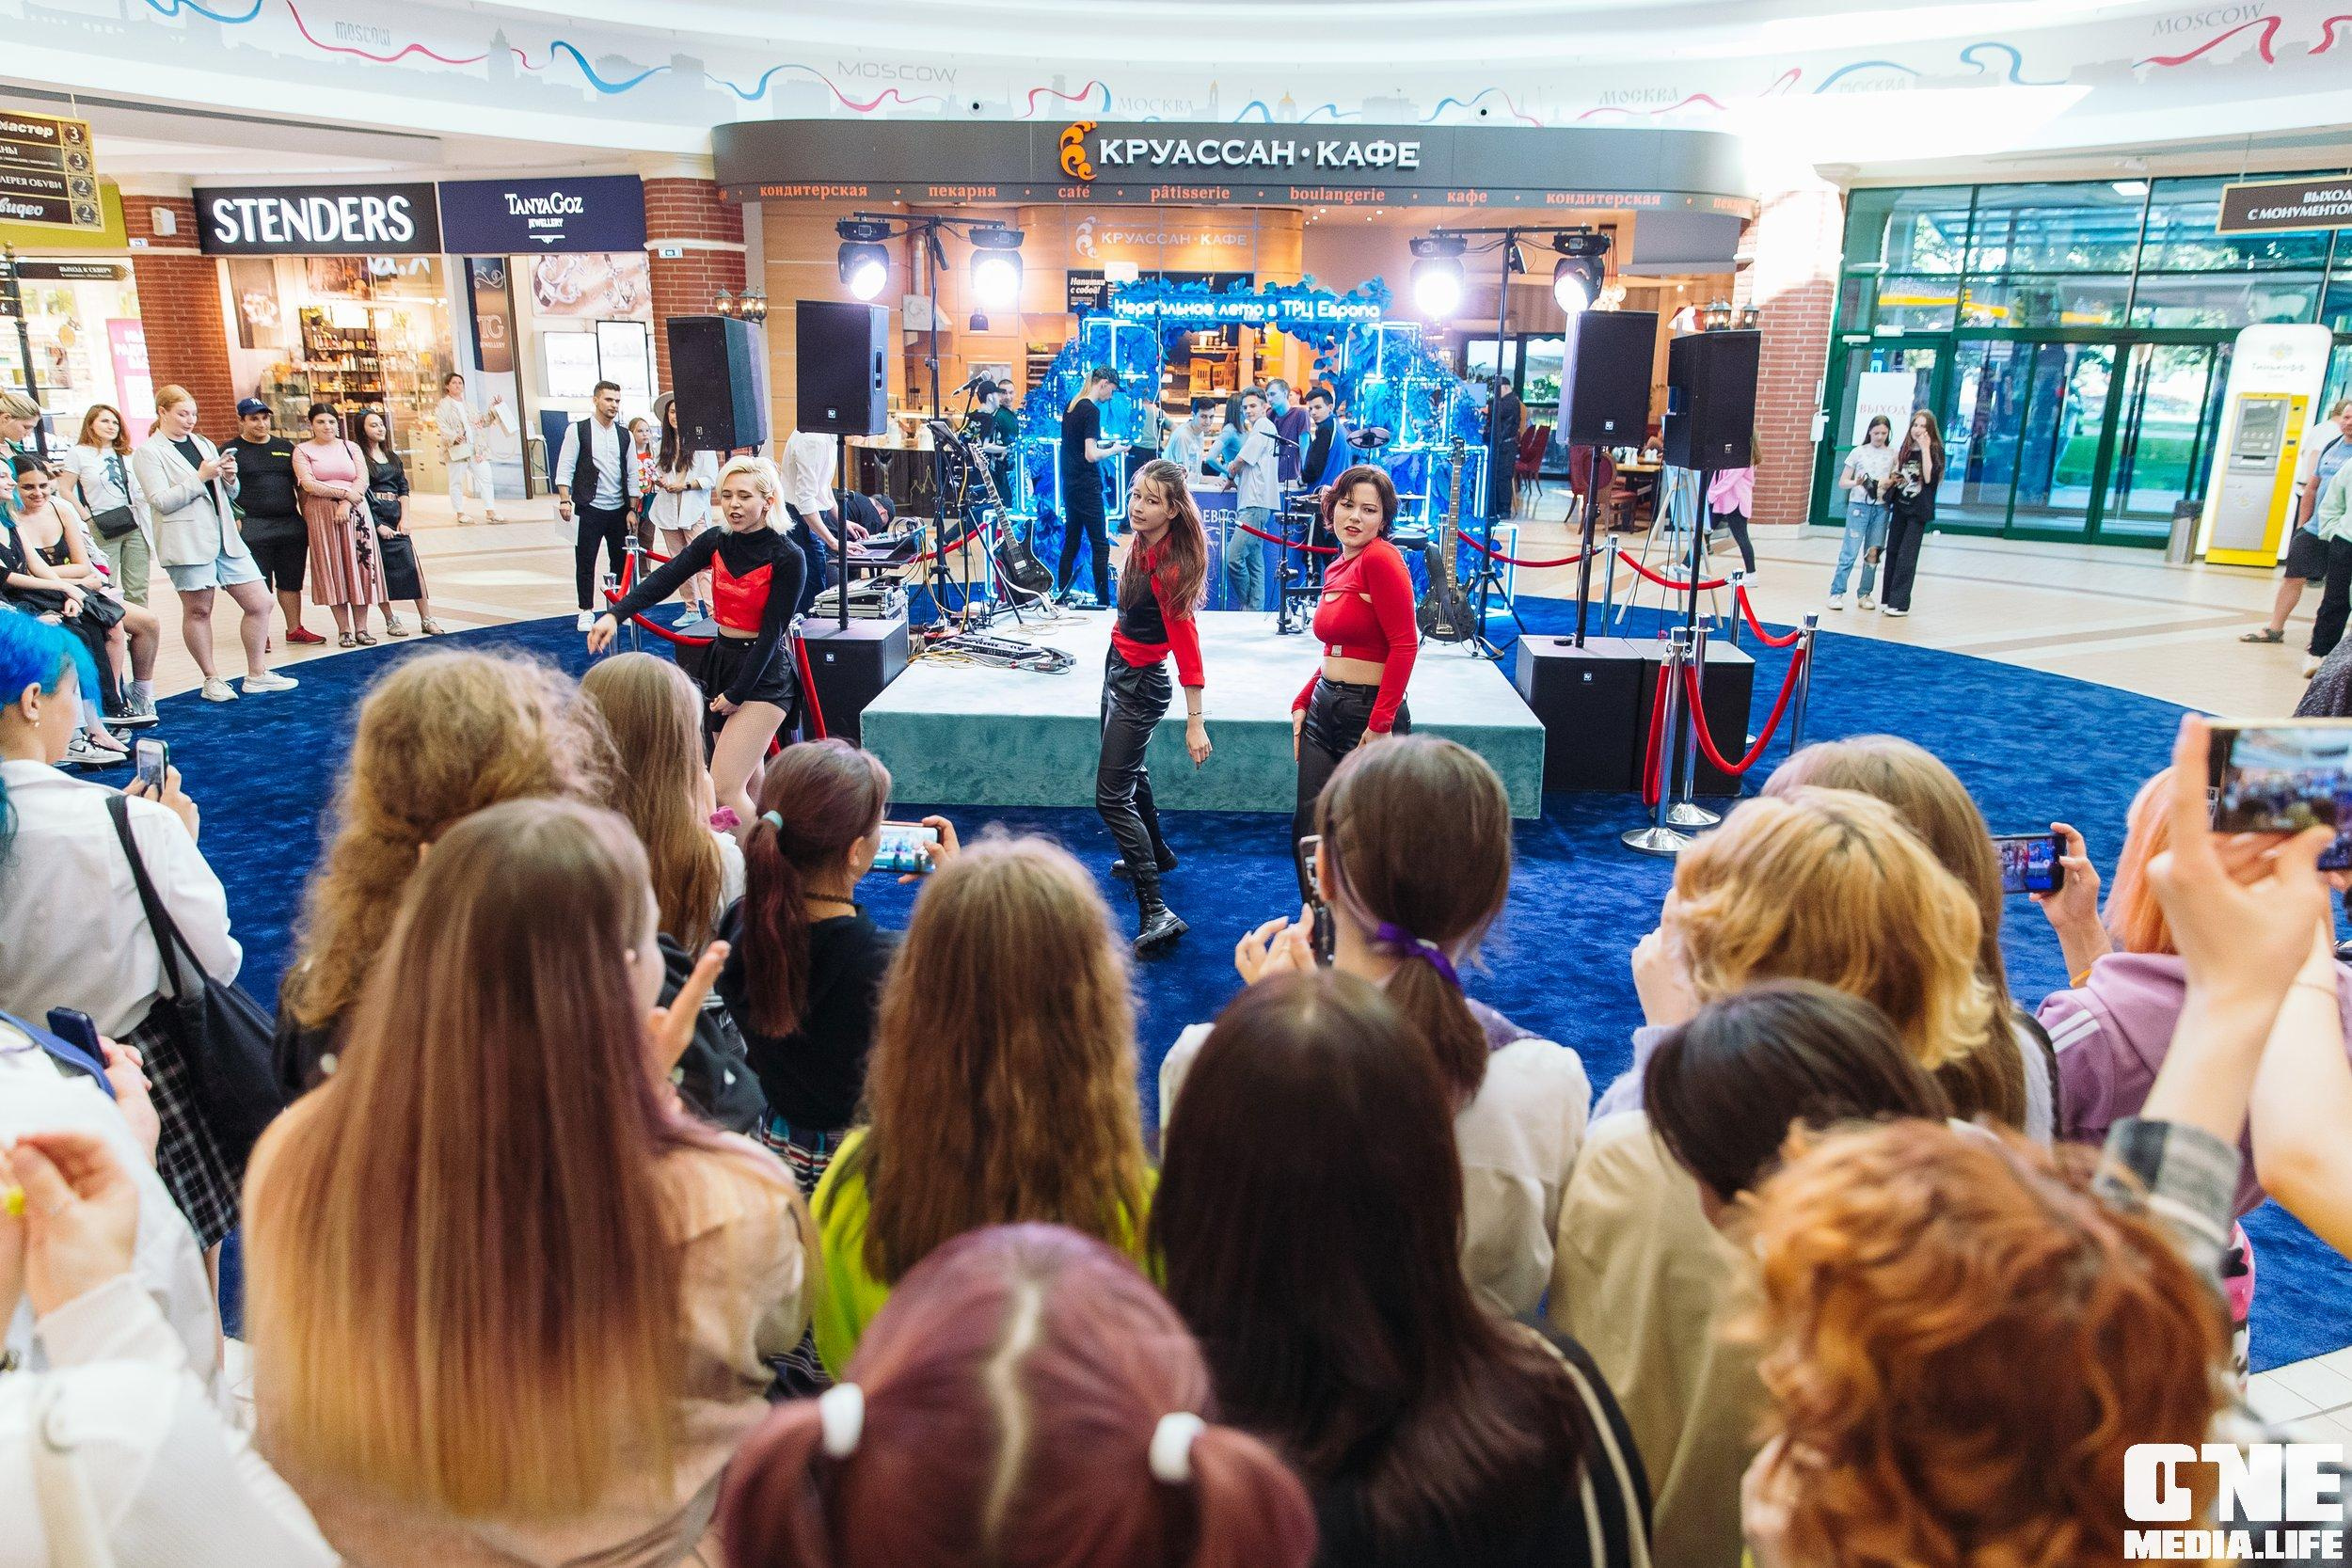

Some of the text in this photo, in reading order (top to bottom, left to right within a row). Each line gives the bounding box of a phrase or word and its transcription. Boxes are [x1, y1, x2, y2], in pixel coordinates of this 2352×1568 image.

[2152, 3, 2265, 37] MOSCOW
[837, 60, 957, 82] MOSCOW
[1117, 96, 1196, 113] МОСКВА
[1099, 138, 1422, 169] КРУАССАН КАФЕ
[759, 184, 867, 200] кондитерская
[929, 184, 997, 200] пекарня
[1150, 183, 1231, 202] pâtisserie
[1290, 186, 1385, 202] boulangerie
[1447, 189, 1488, 205] кафе
[1546, 191, 1661, 210] кондитерская
[213, 195, 415, 244] STENDERS
[1101, 231, 1248, 246] КРУАССАН КАФЕ
[1280, 299, 1314, 320] ТРЦ
[1317, 299, 1381, 320] Европа
